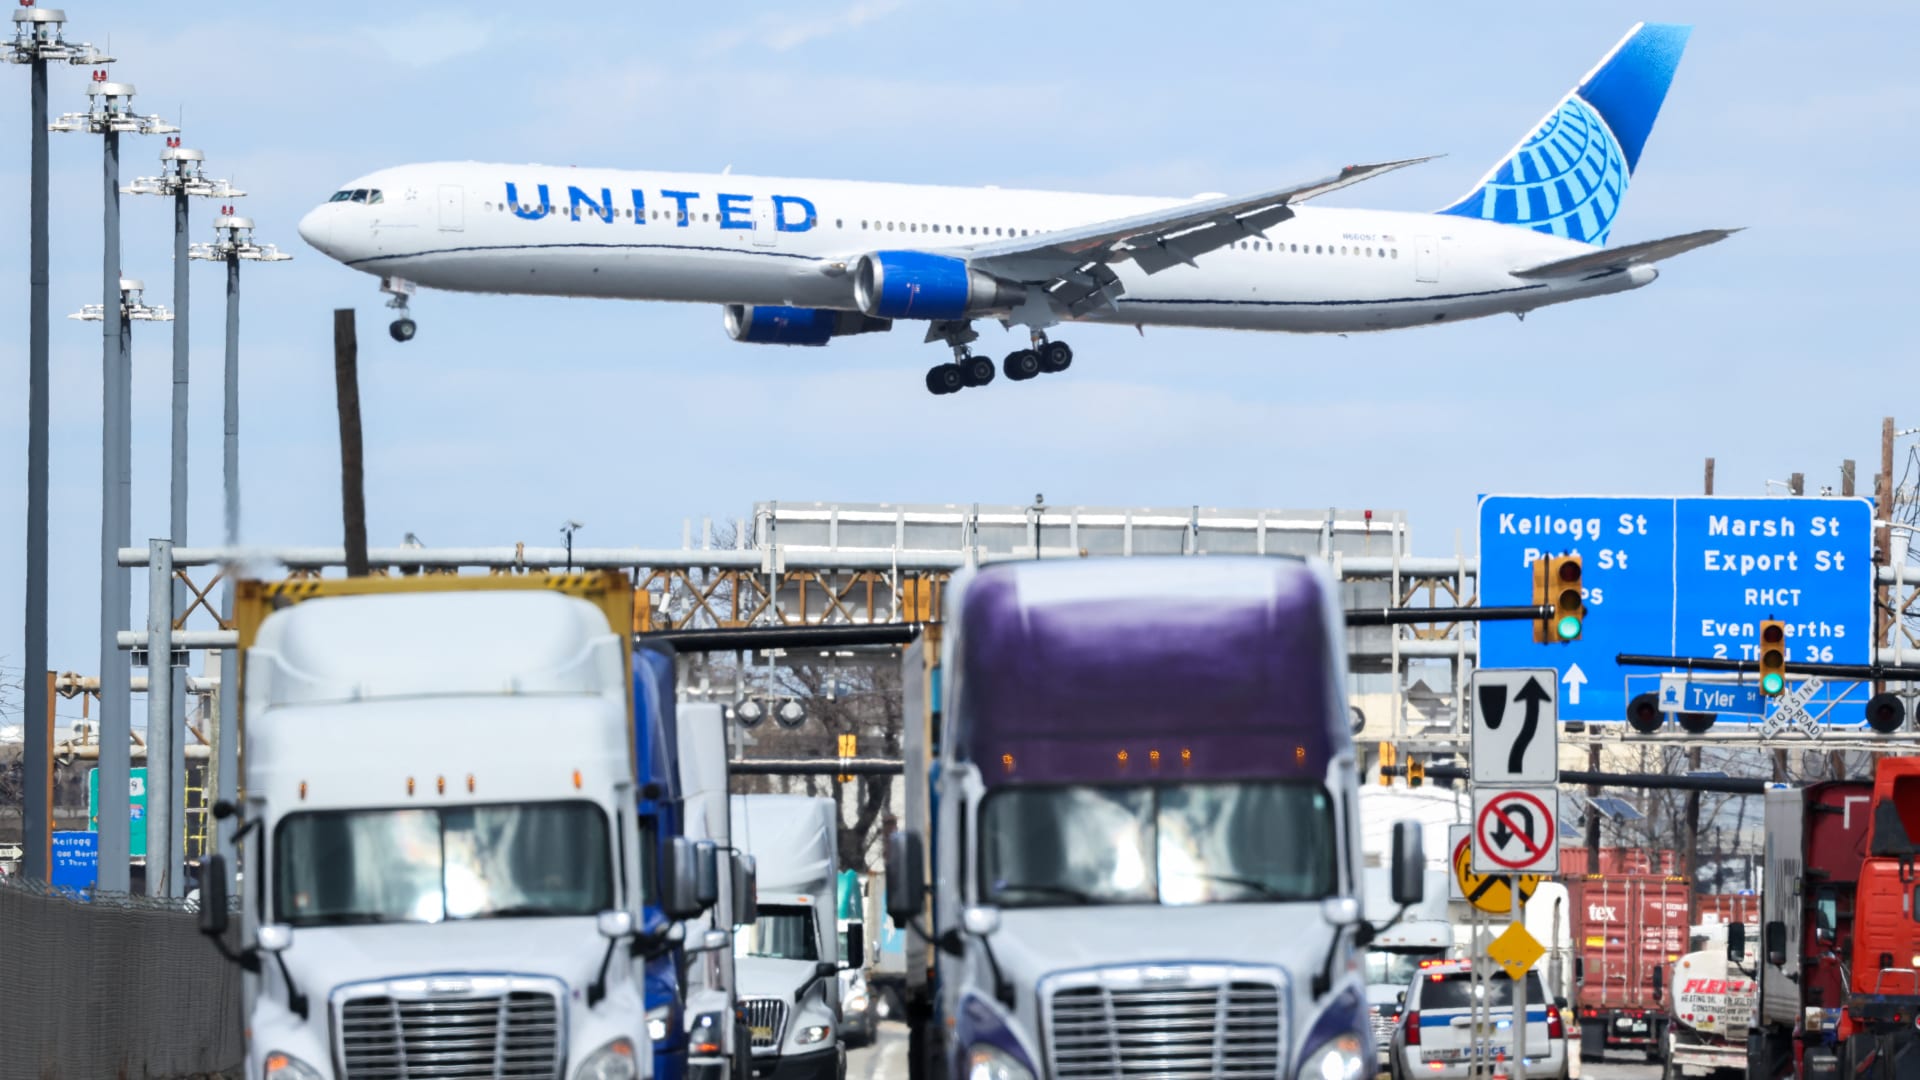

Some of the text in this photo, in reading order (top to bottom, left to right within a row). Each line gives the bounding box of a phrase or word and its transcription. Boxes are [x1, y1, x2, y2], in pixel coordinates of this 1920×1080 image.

[505, 182, 818, 233] UNITED
[1499, 513, 1648, 541] Kellogg St
[1708, 515, 1840, 537] Marsh St
[1597, 549, 1628, 570] St
[1704, 550, 1845, 577] Export St
[1744, 588, 1801, 606] RHCT
[1701, 619, 1846, 638] Even erths
[1713, 643, 1728, 660] 2
[1806, 645, 1834, 662] 36
[1693, 688, 1736, 710] Tyler
[1747, 691, 1756, 702] St
[1762, 679, 1821, 735] CROSSING
[1794, 709, 1820, 735] ROAD
[1588, 903, 1617, 921] tex
